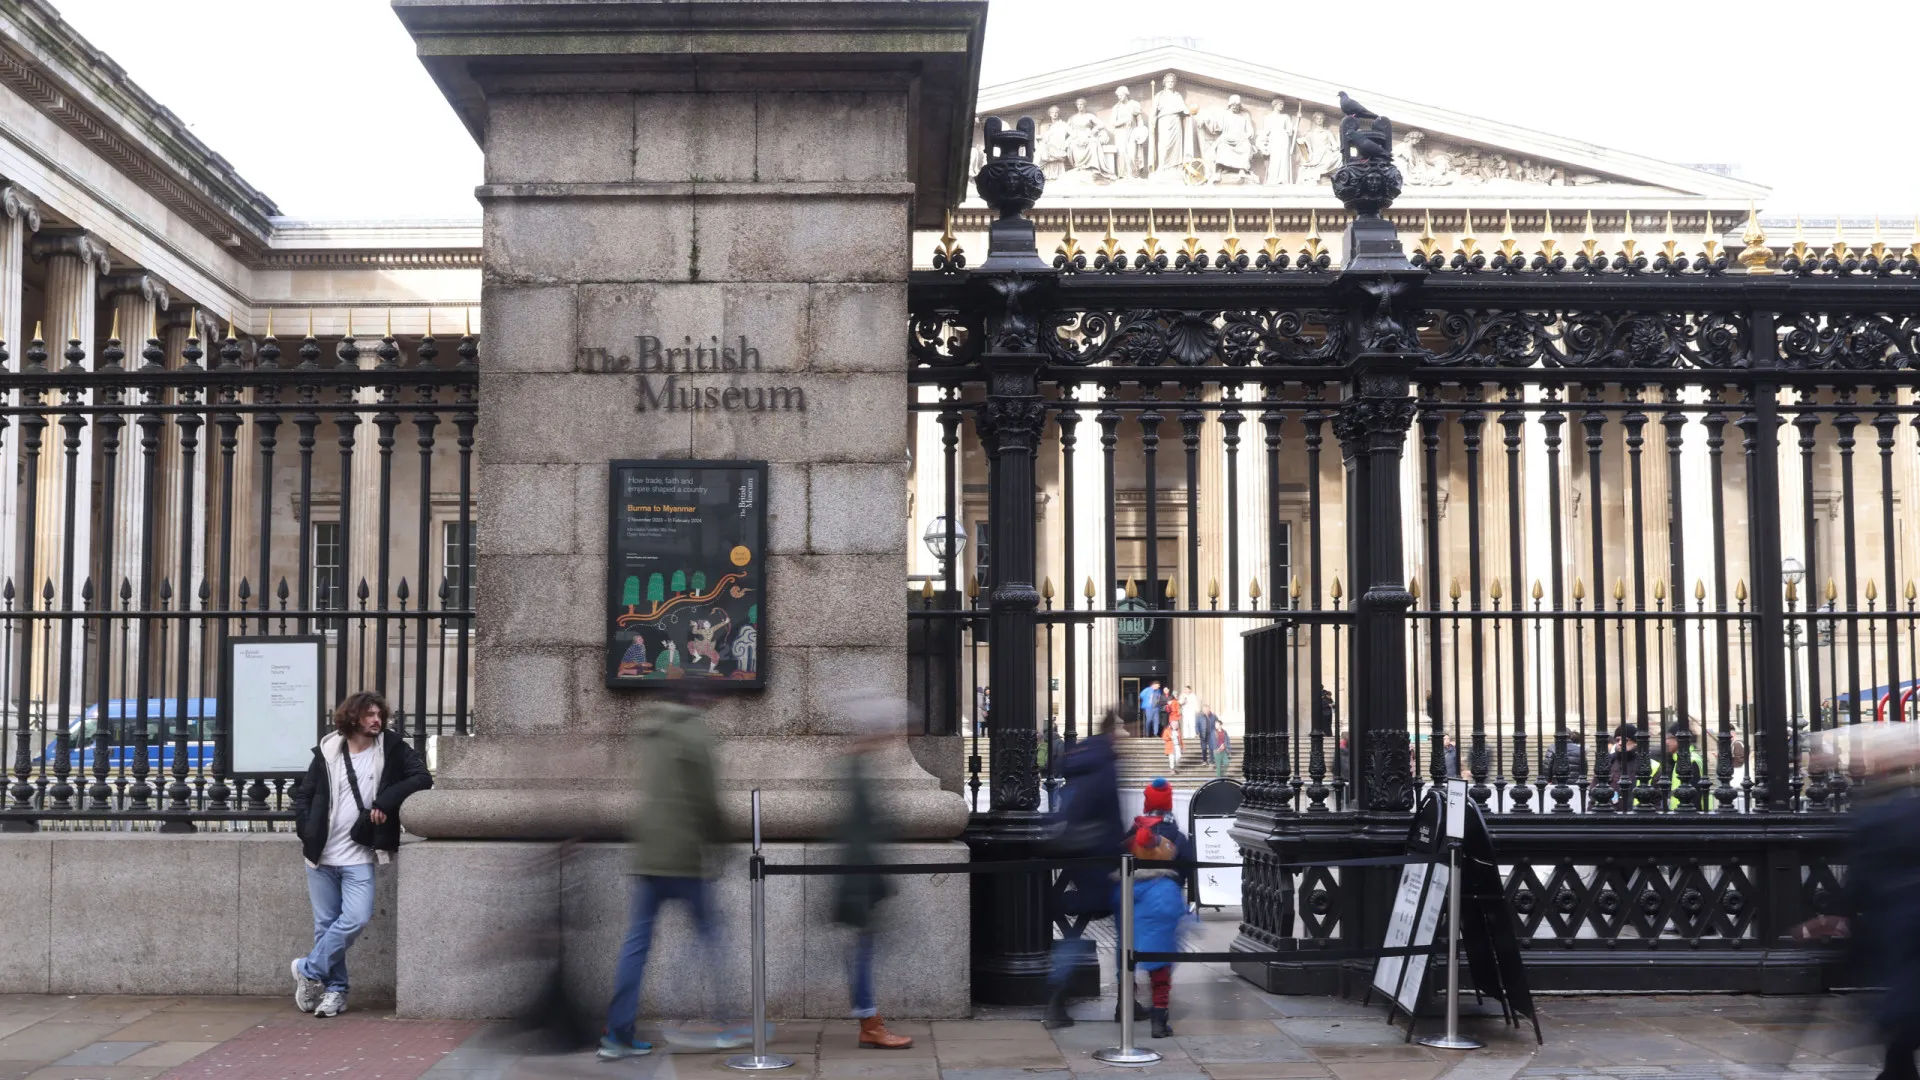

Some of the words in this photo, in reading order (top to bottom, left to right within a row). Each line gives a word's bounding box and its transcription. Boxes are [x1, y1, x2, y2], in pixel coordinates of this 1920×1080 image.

[581, 346, 631, 373] The
[635, 335, 761, 373] British
[635, 374, 807, 412] Museum
[628, 476, 644, 484] How
[645, 477, 663, 485] trade,
[665, 476, 680, 485] faith
[681, 477, 694, 485] and
[628, 486, 651, 494] empire
[652, 486, 676, 494] shaped
[683, 486, 708, 495] country
[738, 485, 747, 508] British
[745, 478, 754, 508] Museum
[627, 504, 652, 512] Burma
[653, 504, 661, 512] to
[662, 504, 696, 514] Myanmar
